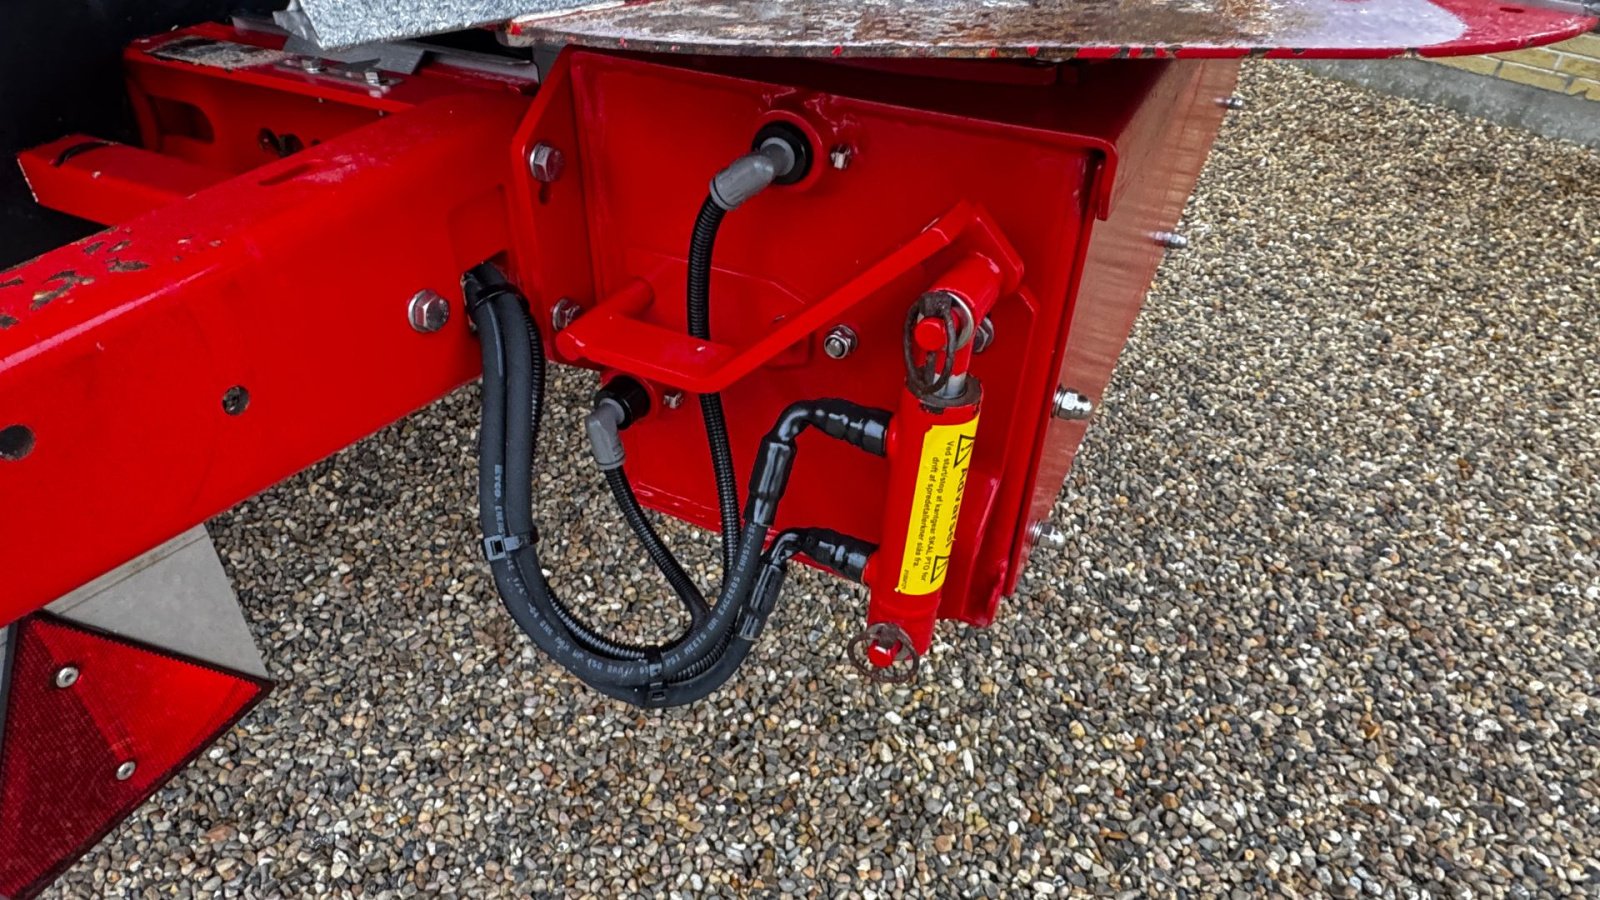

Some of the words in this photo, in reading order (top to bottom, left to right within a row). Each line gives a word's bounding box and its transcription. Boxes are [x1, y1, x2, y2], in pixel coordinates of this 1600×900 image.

[945, 440, 954, 456] Ved
[929, 456, 940, 474] drift
[927, 474, 936, 483] af
[925, 535, 936, 556] SKAL
[922, 556, 932, 573] PTO
[684, 633, 708, 656] MEETS
[707, 617, 720, 632] OR
[718, 577, 741, 616] EXCEEDS
